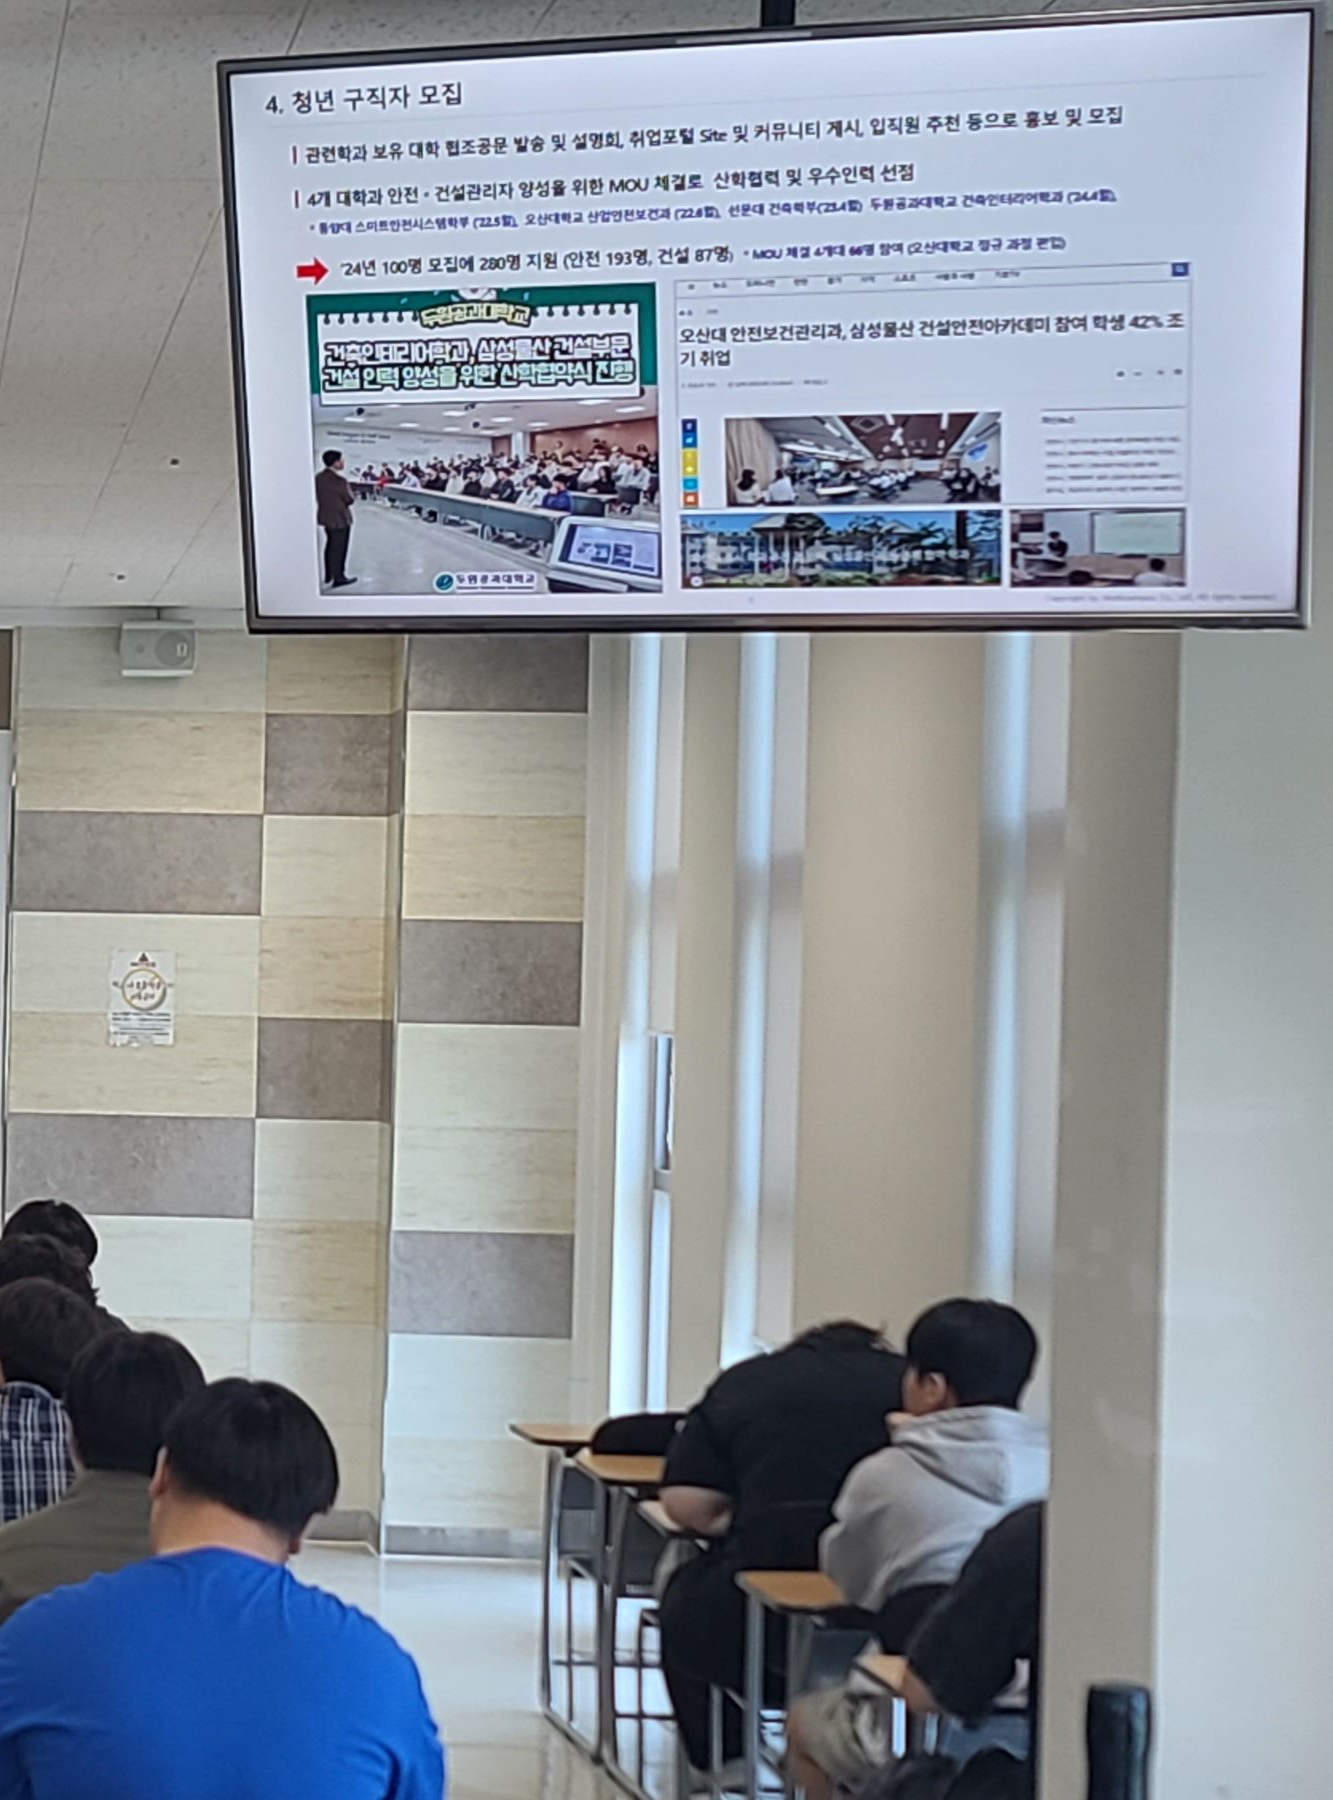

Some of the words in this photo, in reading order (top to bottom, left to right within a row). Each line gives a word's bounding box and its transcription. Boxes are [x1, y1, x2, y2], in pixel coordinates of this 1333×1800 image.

[266, 96, 285, 114] 4.
[292, 89, 335, 114] 청년
[343, 85, 411, 111] 구직자
[419, 81, 462, 105] 모집
[305, 144, 367, 164] 관련학과
[372, 142, 404, 162] 보유
[408, 140, 440, 159] 대학
[444, 137, 508, 158] 협조공문
[513, 134, 546, 154] 발송
[551, 133, 566, 152] 및
[572, 131, 624, 151] 설명회,
[629, 127, 694, 148] 취업포털
[700, 127, 728, 143] Site
[733, 124, 748, 143] 및
[754, 120, 821, 142] 커뮤니티
[826, 118, 864, 138] 게시,
[926, 113, 960, 133] 추천
[966, 112, 1018, 131] 등으로
[1023, 110, 1059, 129] 홍보
[1065, 107, 1082, 127] 및
[1087, 105, 1123, 125] 모집
[307, 190, 331, 208] 4개
[336, 187, 383, 207] 대학과
[387, 185, 419, 204] 안전
[434, 182, 513, 202] 건설관리자
[518, 179, 566, 199] 양성을
[571, 178, 604, 197] 위한
[609, 178, 649, 193] MOU
[653, 173, 704, 192] 체결로
[713, 169, 780, 189] 산학협력
[786, 168, 802, 186] 및
[807, 165, 875, 185] 우수인력
[880, 163, 914, 183] 선점
[383, 256, 422, 275] 100명
[428, 254, 475, 274] 모집에
[479, 253, 520, 272] 280명
[526, 251, 558, 270] 지원
[563, 249, 601, 271] (안전
[606, 248, 653, 268] 193명,
[657, 245, 689, 265] 건설
[694, 244, 733, 264] 87명)
[752, 248, 783, 260] MOU
[679, 327, 726, 346] 오산대
[731, 322, 847, 345] 안전보건관리과,
[849, 319, 914, 341] 삼성물산
[918, 315, 1050, 338] 건설안전아카데미
[1055, 314, 1088, 333] 참여
[1092, 313, 1126, 332] 학생
[1167, 312, 1185, 329] 조
[325, 339, 475, 369] 건축인테리어학과,
[478, 336, 552, 363] 삼성물산
[553, 333, 630, 361] 건설부문
[679, 349, 696, 367] 기
[700, 348, 731, 367] 취업
[323, 365, 360, 391] 건설
[363, 366, 399, 390] 인력
[402, 364, 457, 389] 양성을
[460, 363, 498, 388] 위한
[595, 358, 634, 384] 진행
